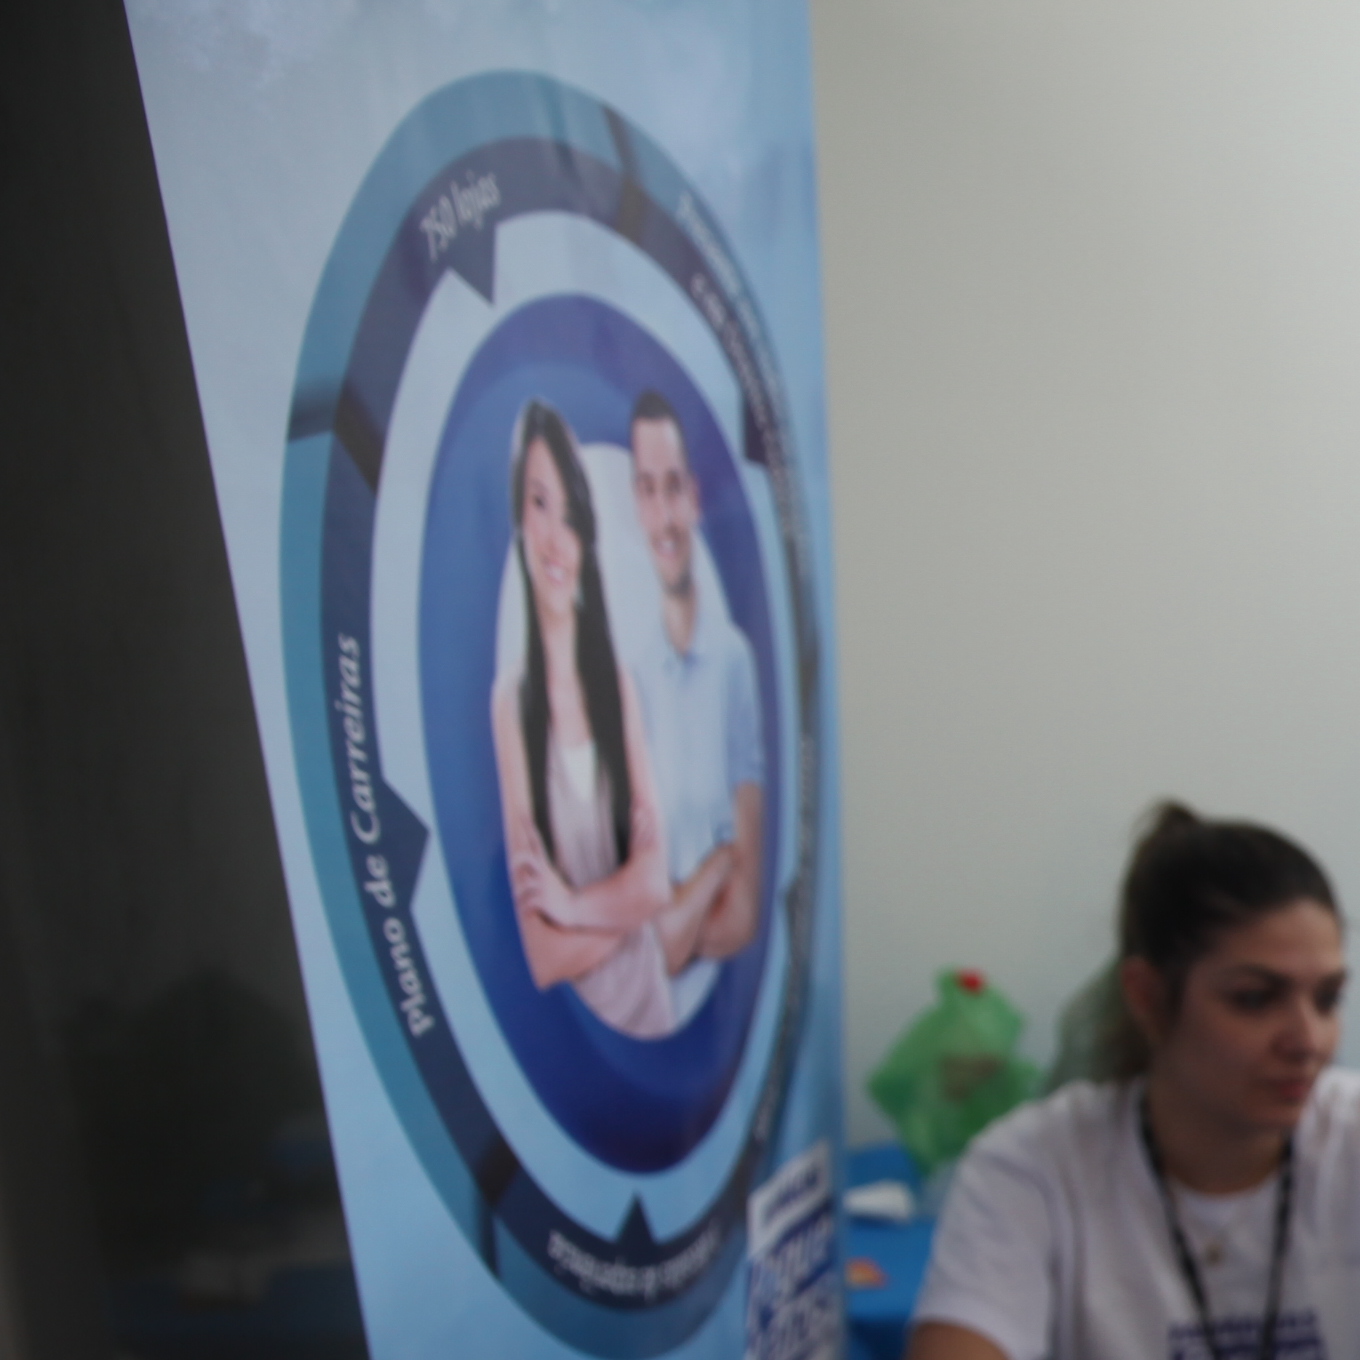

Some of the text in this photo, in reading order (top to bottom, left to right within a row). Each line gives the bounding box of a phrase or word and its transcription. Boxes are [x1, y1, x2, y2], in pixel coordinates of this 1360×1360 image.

[419, 194, 457, 262] 750
[335, 632, 434, 1037] Plano de Carreiras
